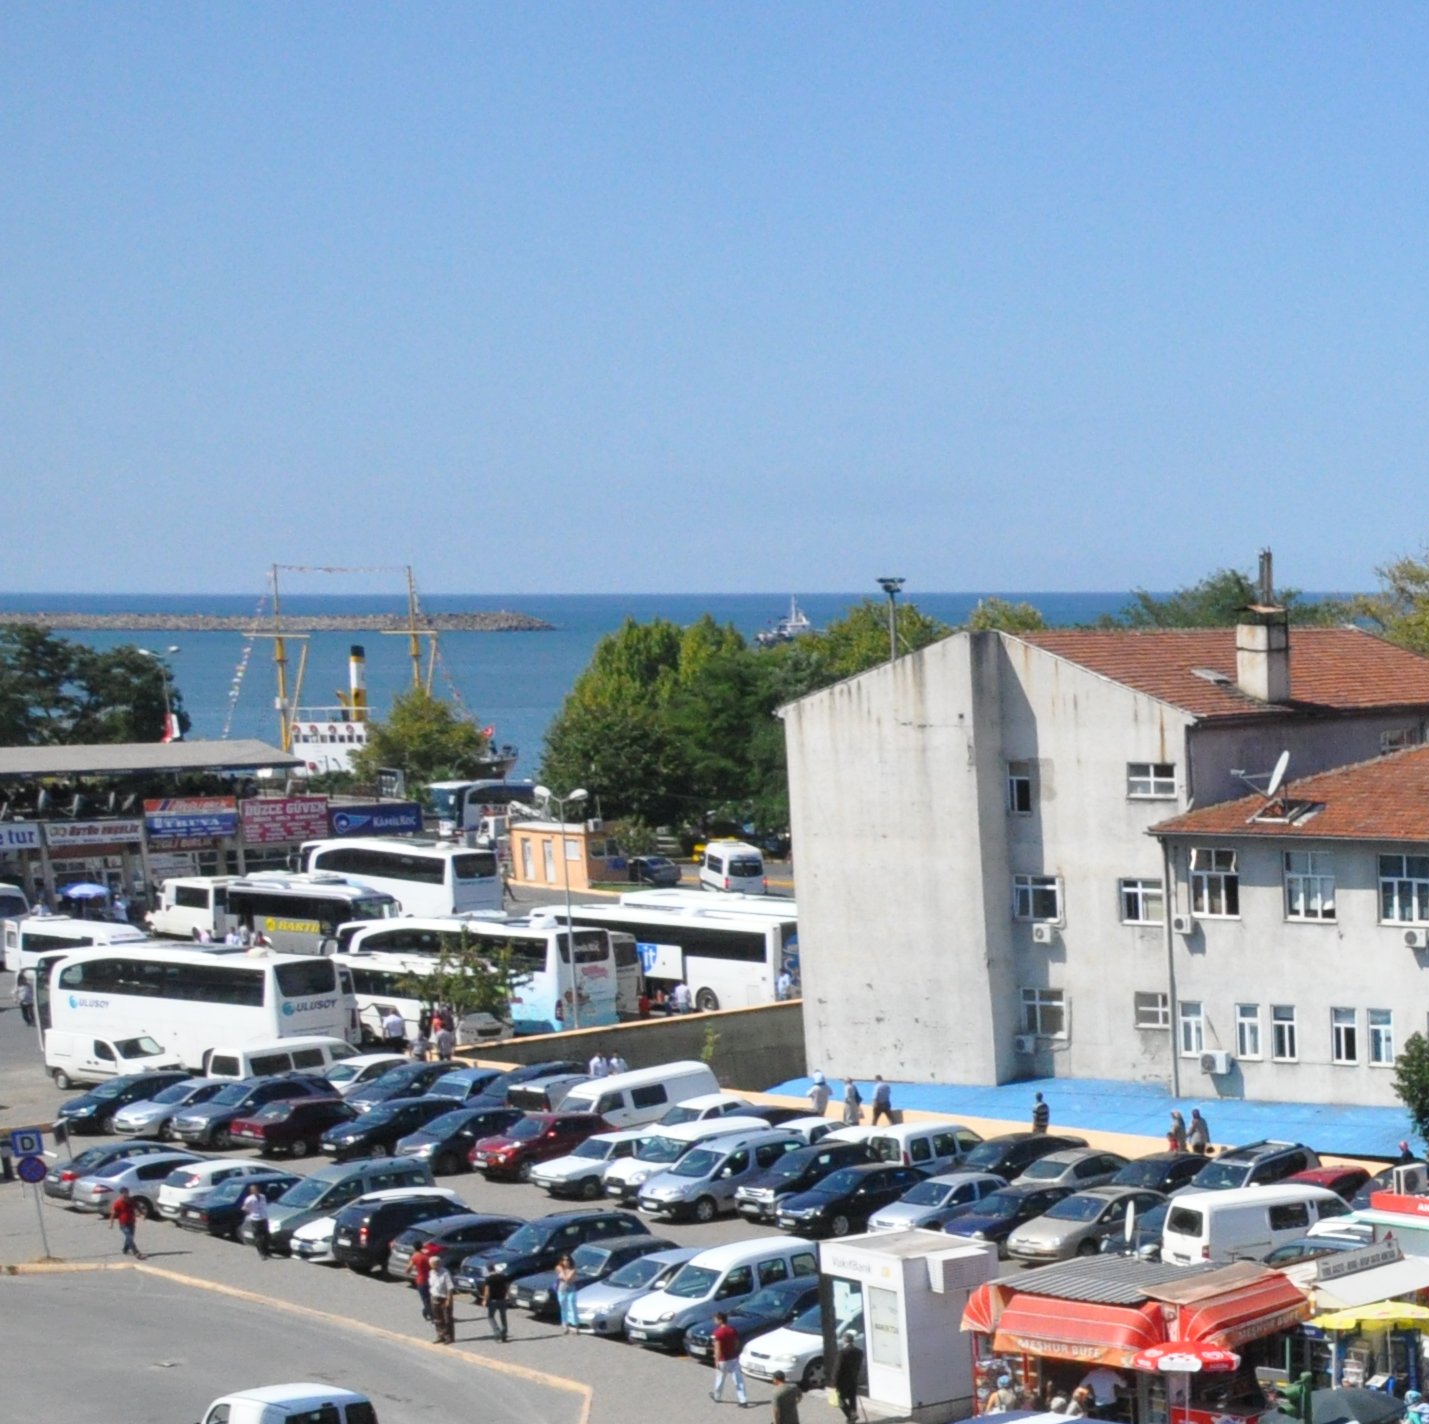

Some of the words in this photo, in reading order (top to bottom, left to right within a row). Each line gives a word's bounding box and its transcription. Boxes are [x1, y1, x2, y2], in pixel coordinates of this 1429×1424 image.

[9, 830, 35, 845] tur
[78, 1000, 109, 1010] ULUSOY
[295, 1000, 338, 1012] ULUSOY
